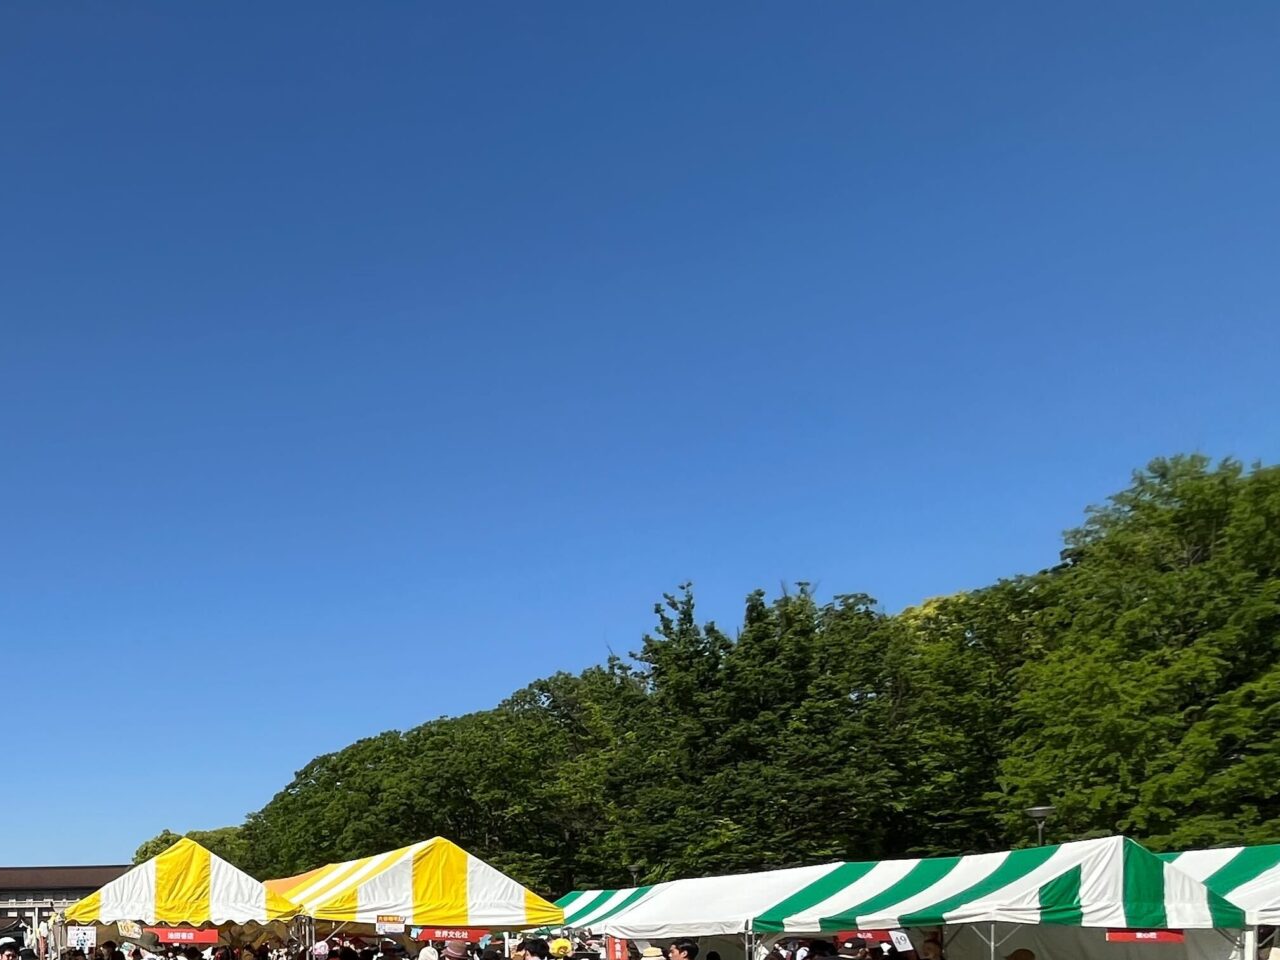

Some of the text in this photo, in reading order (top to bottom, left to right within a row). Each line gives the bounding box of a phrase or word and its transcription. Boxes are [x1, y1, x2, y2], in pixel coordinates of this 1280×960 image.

[434, 930, 469, 939] 世界文化社
[895, 935, 908, 946] 49
